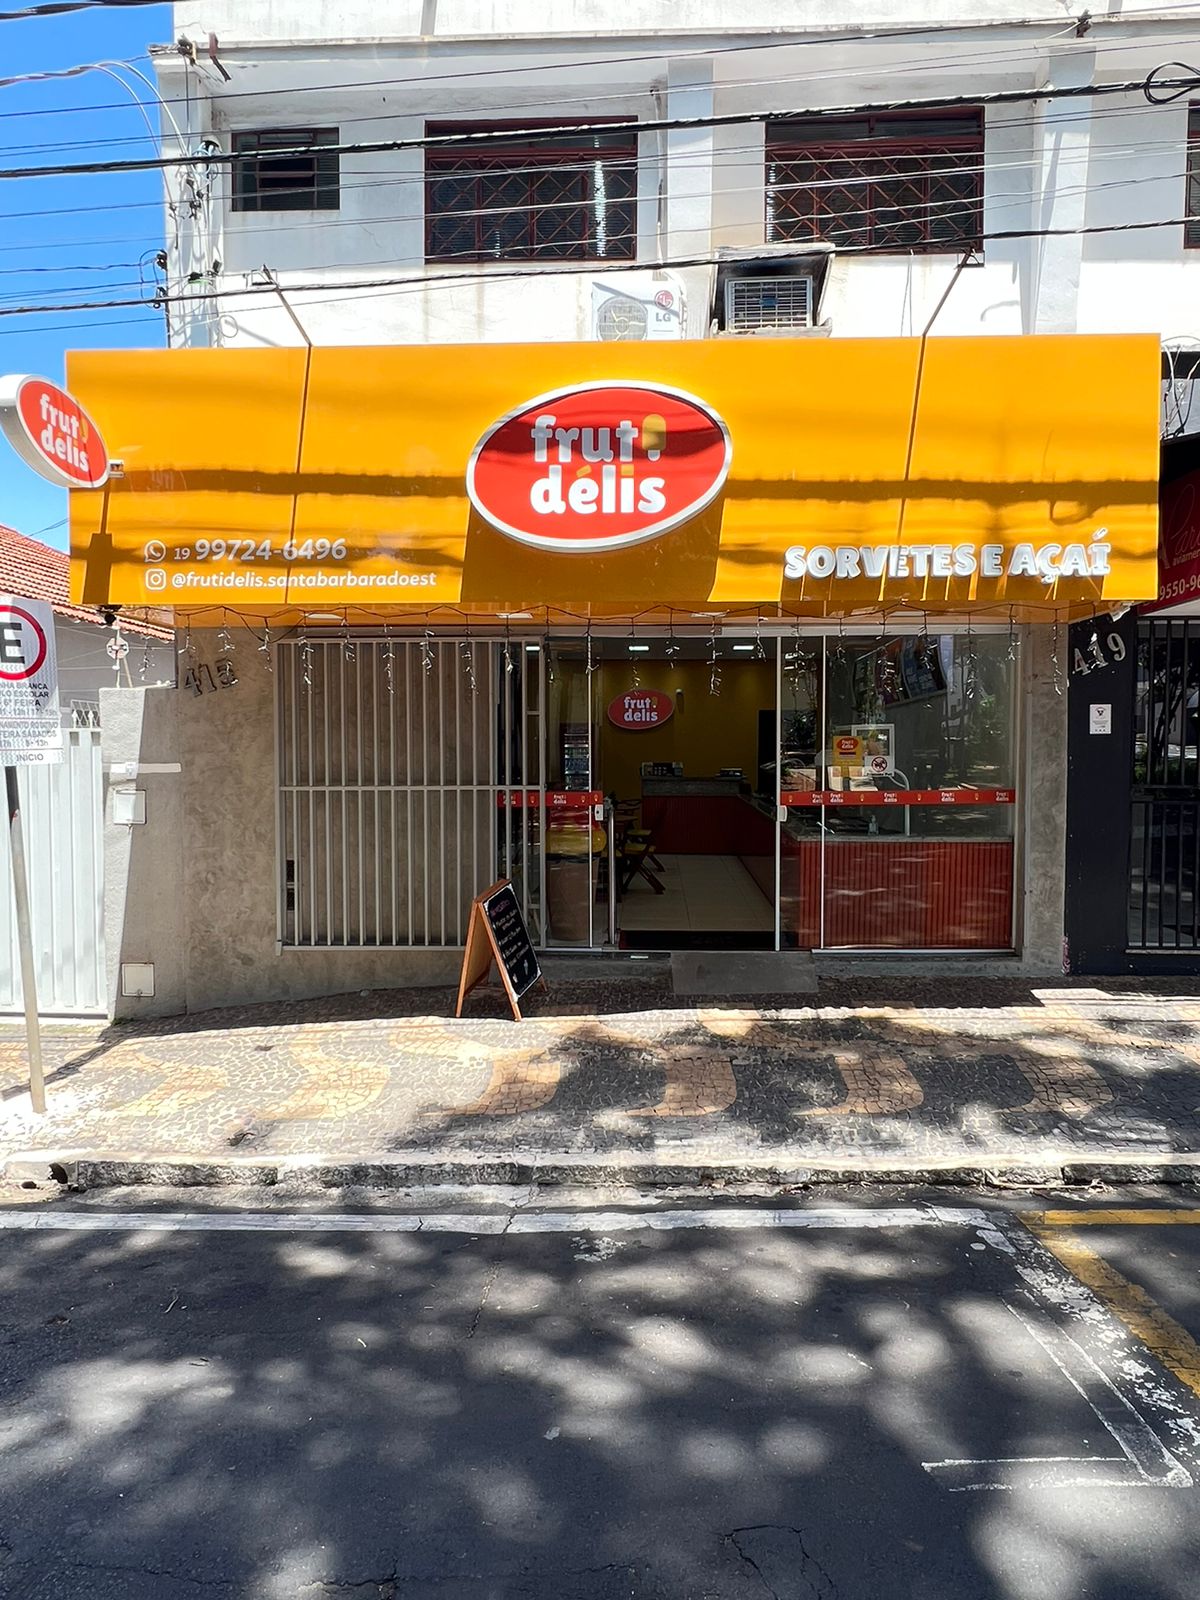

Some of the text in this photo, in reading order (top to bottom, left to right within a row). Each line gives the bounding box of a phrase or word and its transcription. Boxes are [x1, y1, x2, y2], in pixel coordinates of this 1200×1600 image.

[655, 312, 672, 322] LG
[530, 464, 667, 514] délis
[174, 538, 347, 561] 19 99724-6496
[784, 527, 1112, 584] SORVETES E AÇAÍ
[171, 570, 437, 588] @frutidelis.santabarbaradoest
[0, 622, 25, 664] E
[13, 690, 49, 698] ESCOLAR
